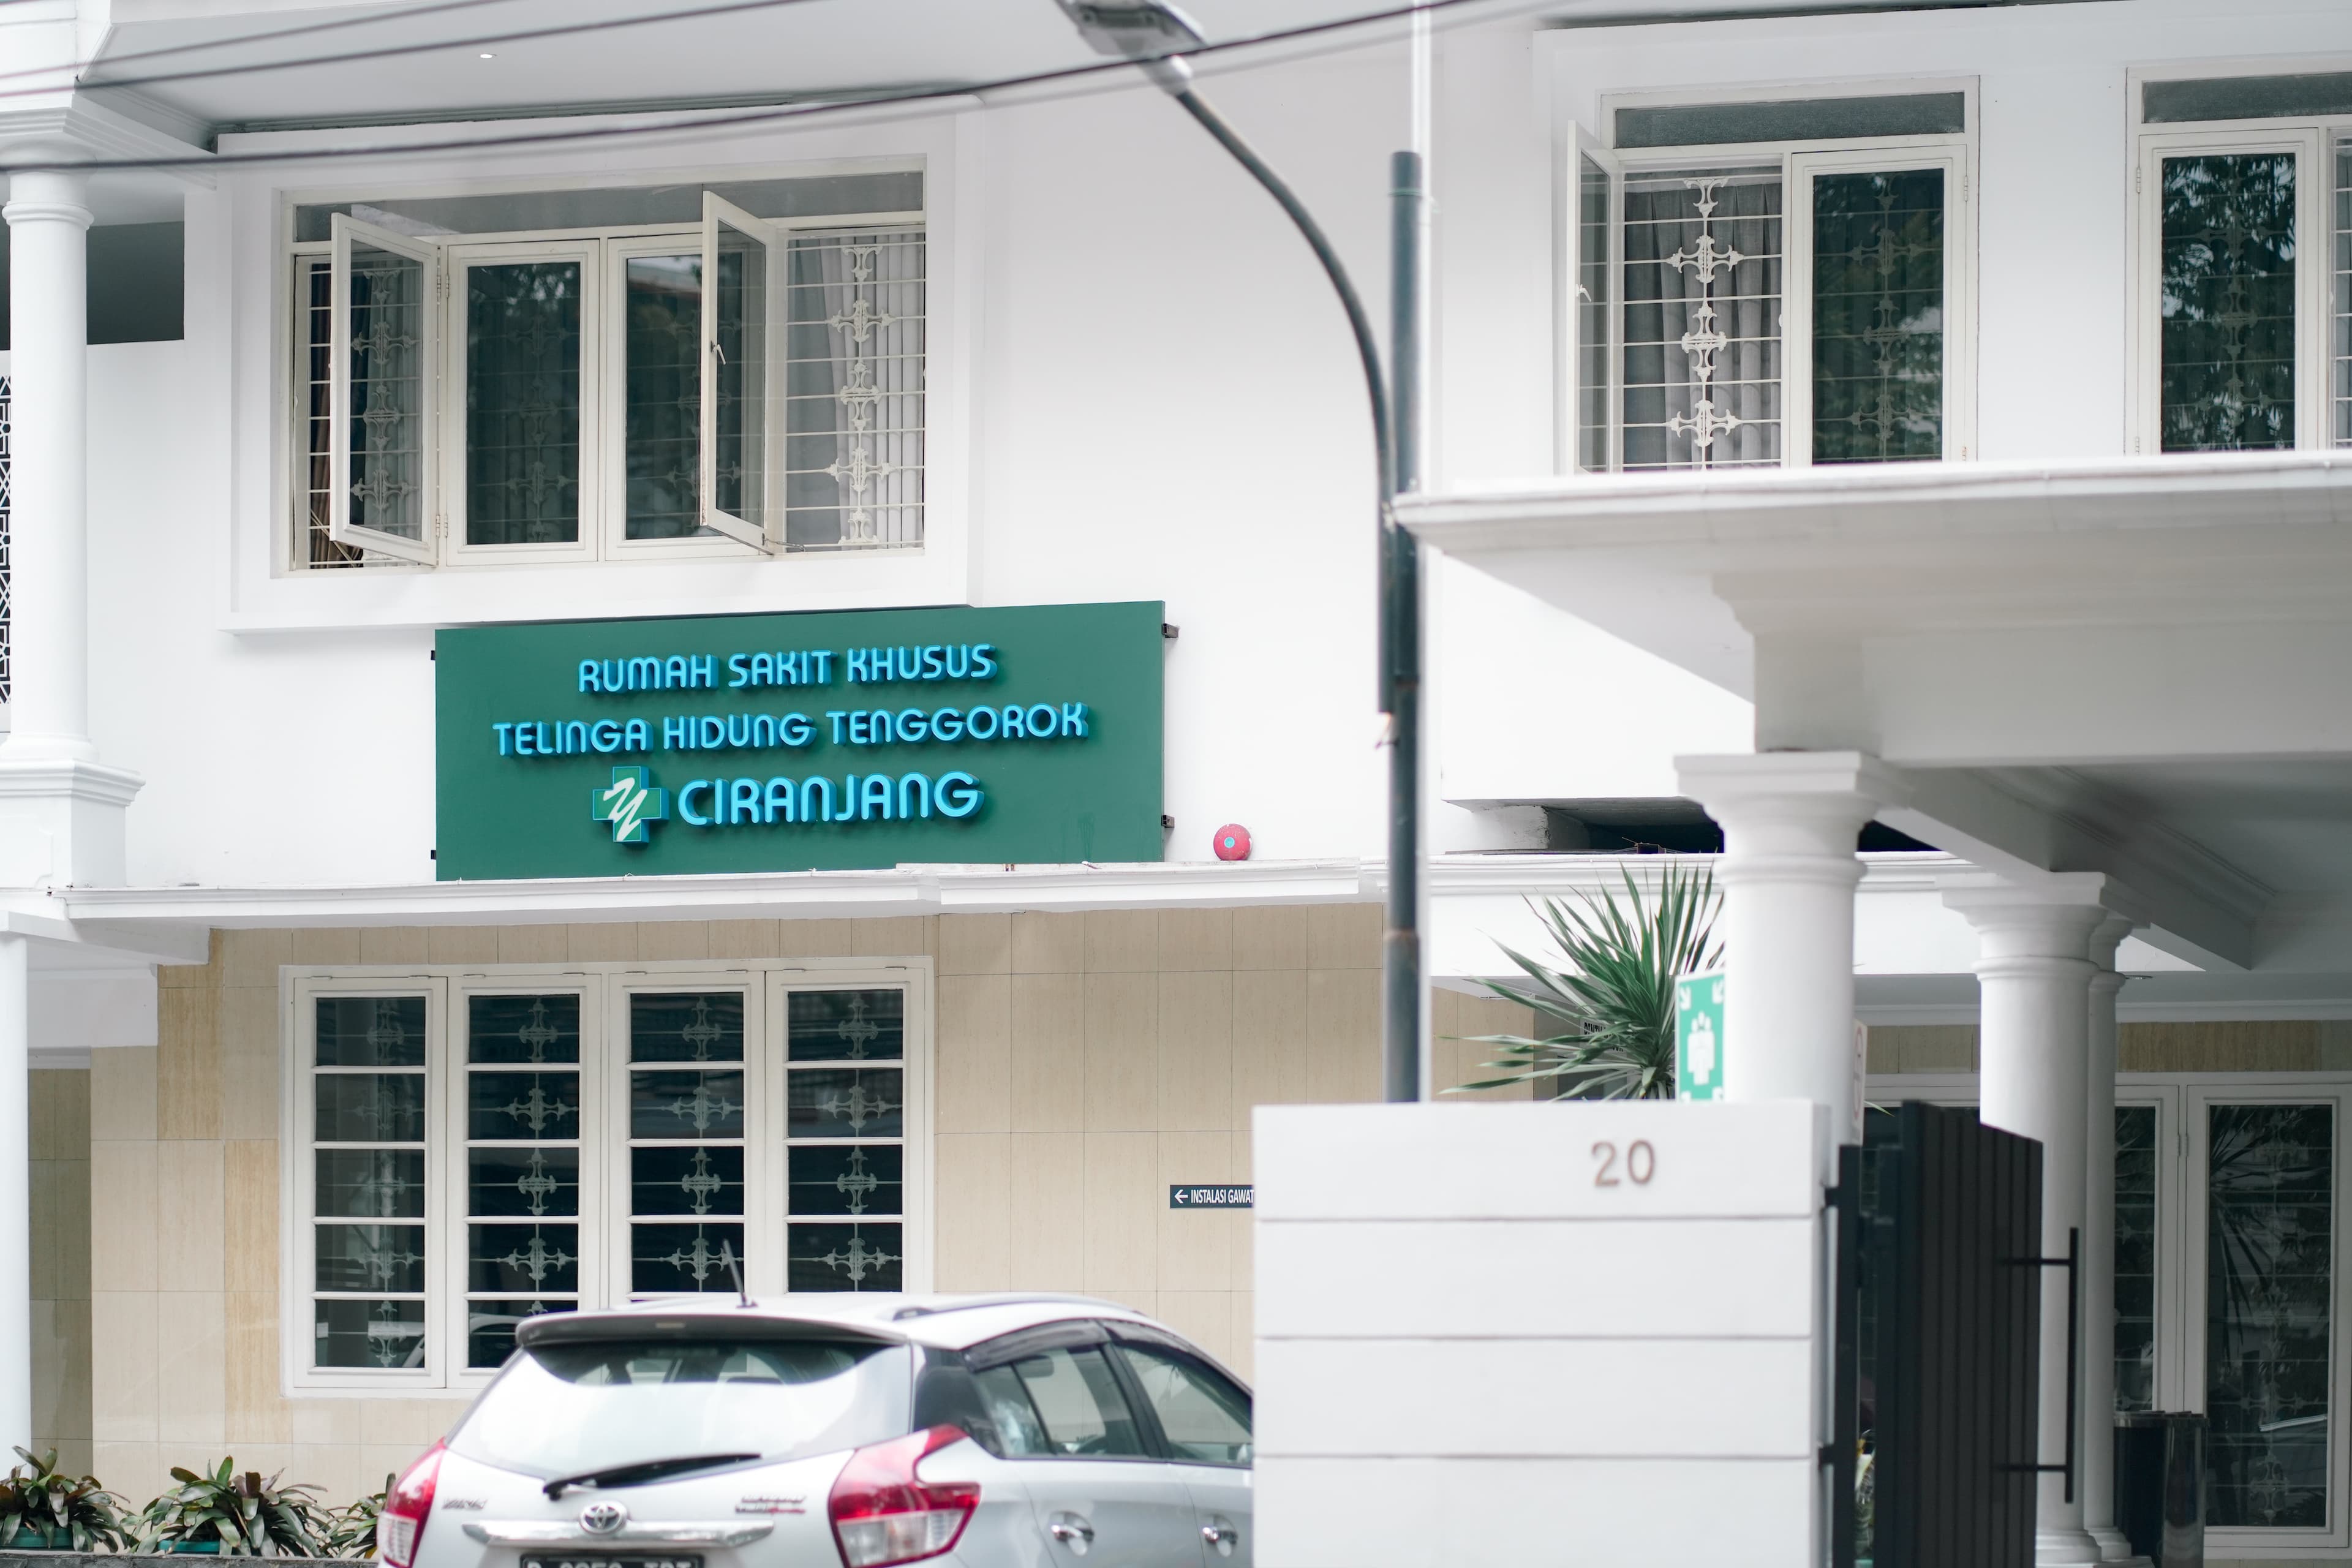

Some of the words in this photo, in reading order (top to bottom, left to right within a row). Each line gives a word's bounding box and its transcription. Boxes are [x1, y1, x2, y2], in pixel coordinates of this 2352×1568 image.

[579, 654, 715, 693] RUMAH
[728, 650, 834, 688] SAKIT
[847, 644, 995, 683] KHUSUS
[493, 718, 650, 756] TELINGA
[663, 712, 814, 750] HIDUNG
[825, 703, 1085, 745] TENGGOROK
[678, 771, 982, 826] CIRANJANG
[1591, 1139, 1656, 1188] 20
[1191, 1189, 1226, 1203] INSTALASI
[1227, 1189, 1254, 1203] GAWAT
